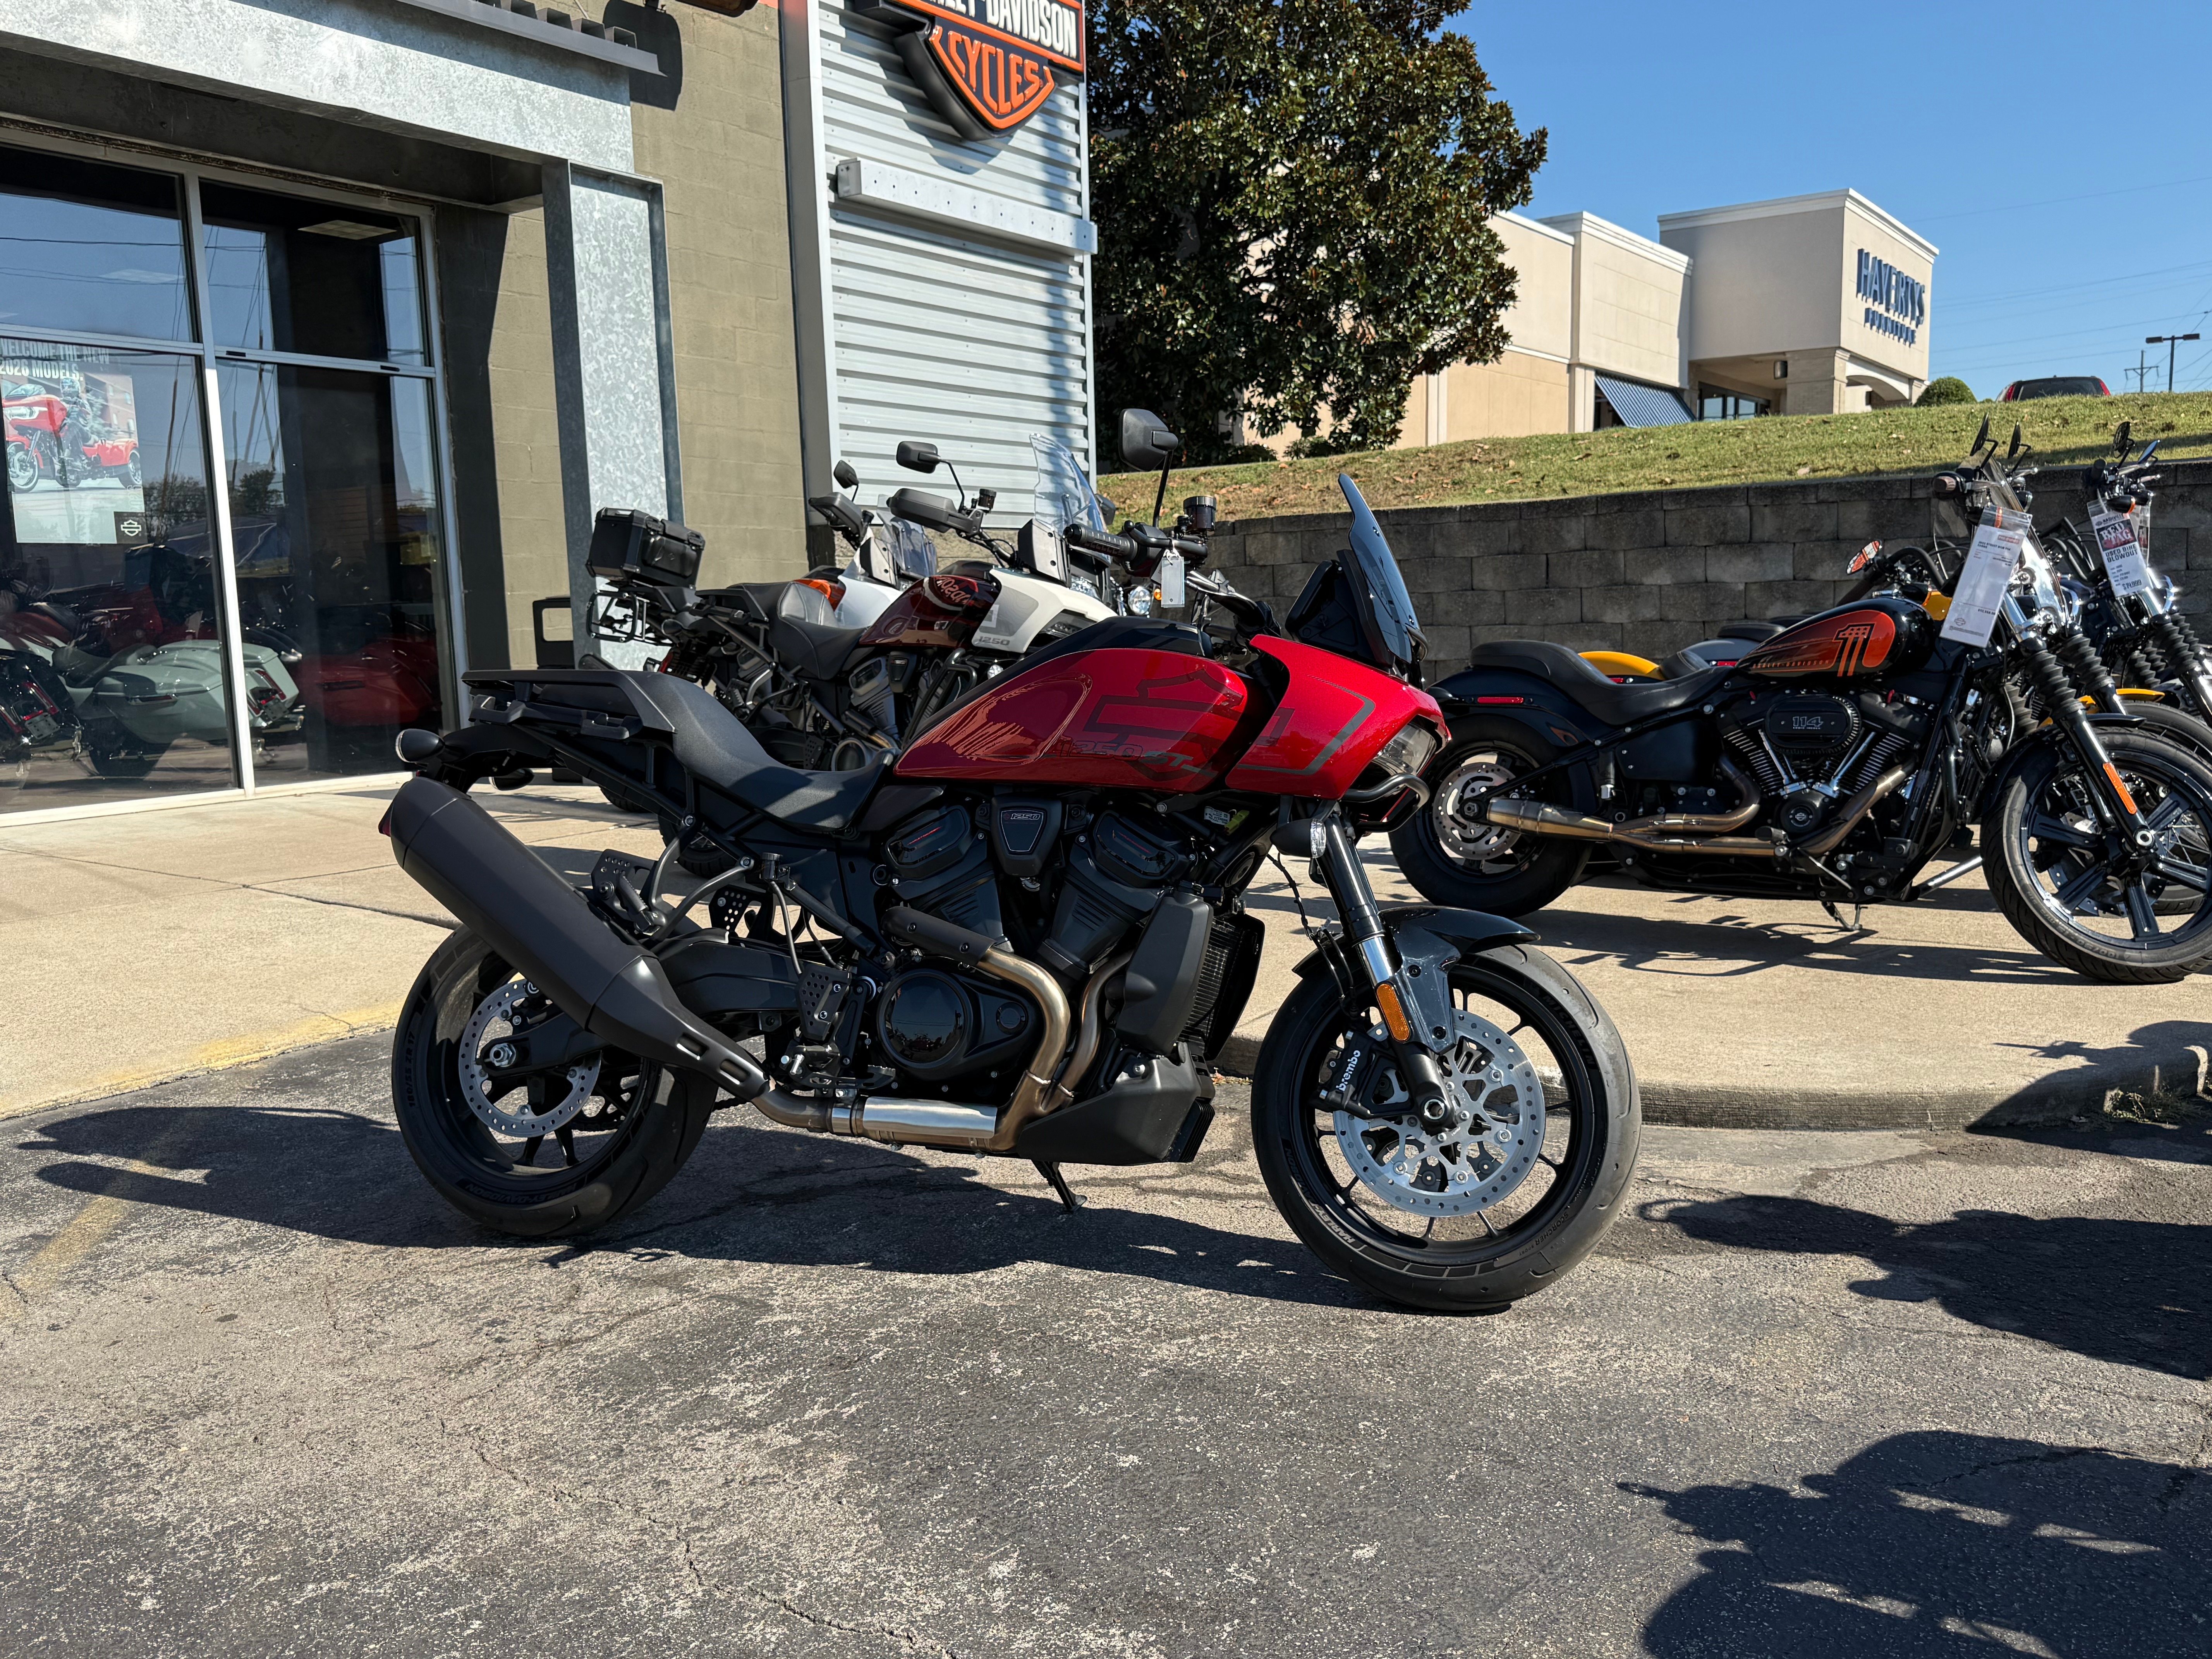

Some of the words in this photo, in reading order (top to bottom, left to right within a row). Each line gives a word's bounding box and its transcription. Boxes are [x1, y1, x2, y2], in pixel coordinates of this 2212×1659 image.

[948, 31, 1041, 115] CYCLES
[59, 344, 81, 361] THE
[83, 347, 110, 364] NEW
[0, 358, 29, 376] 2026
[32, 360, 83, 381] MODELS.
[2100, 522, 2125, 540] RED
[2110, 529, 2132, 545] TAG
[2106, 548, 2121, 557] USED
[2107, 550, 2138, 563] BLOWOUT
[979, 636, 1010, 646] 1250
[1793, 716, 1824, 727] 114
[1543, 995, 1595, 1065] MICHELIN
[1336, 1050, 1361, 1091] brembo
[1285, 1147, 1356, 1243] HARLEY-DAVIDSON
[1535, 1211, 1568, 1245] SCORCHER
